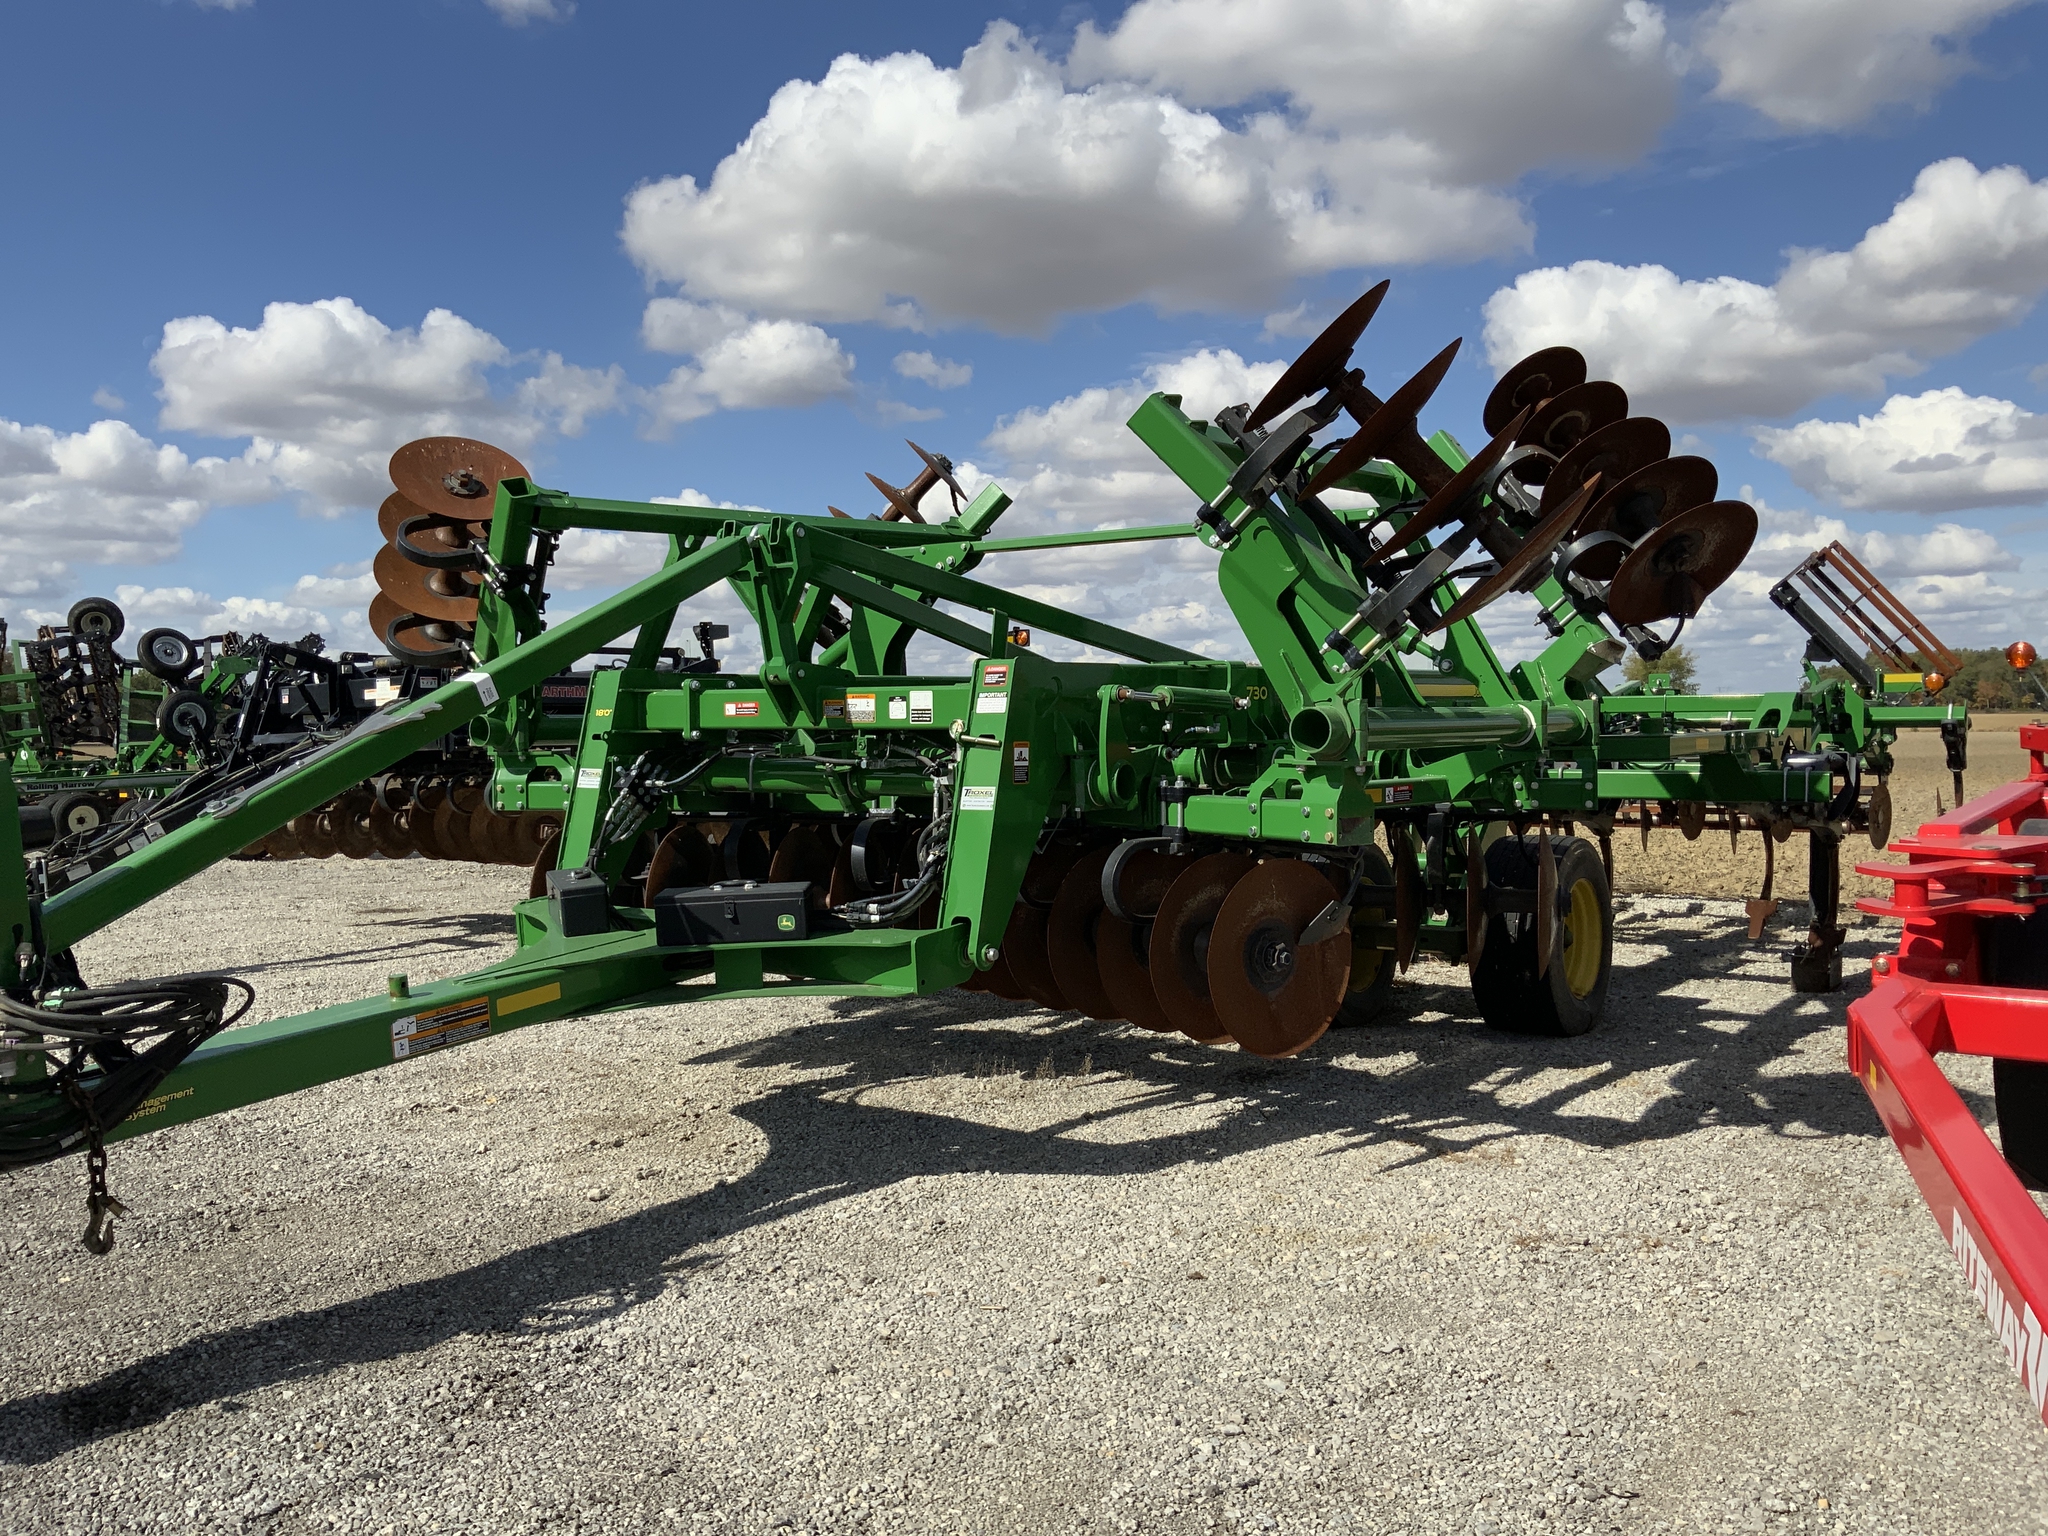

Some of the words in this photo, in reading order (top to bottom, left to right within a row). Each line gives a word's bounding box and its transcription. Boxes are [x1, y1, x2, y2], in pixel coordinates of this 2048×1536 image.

[541, 685, 588, 698] ARTHM
[1246, 686, 1268, 700] 730
[26, 782, 59, 791] Rolling
[61, 781, 95, 789] Harrow
[964, 788, 993, 797] TROXEL
[136, 1086, 195, 1110] nagement
[1952, 1206, 2030, 1380] RITEWAY
